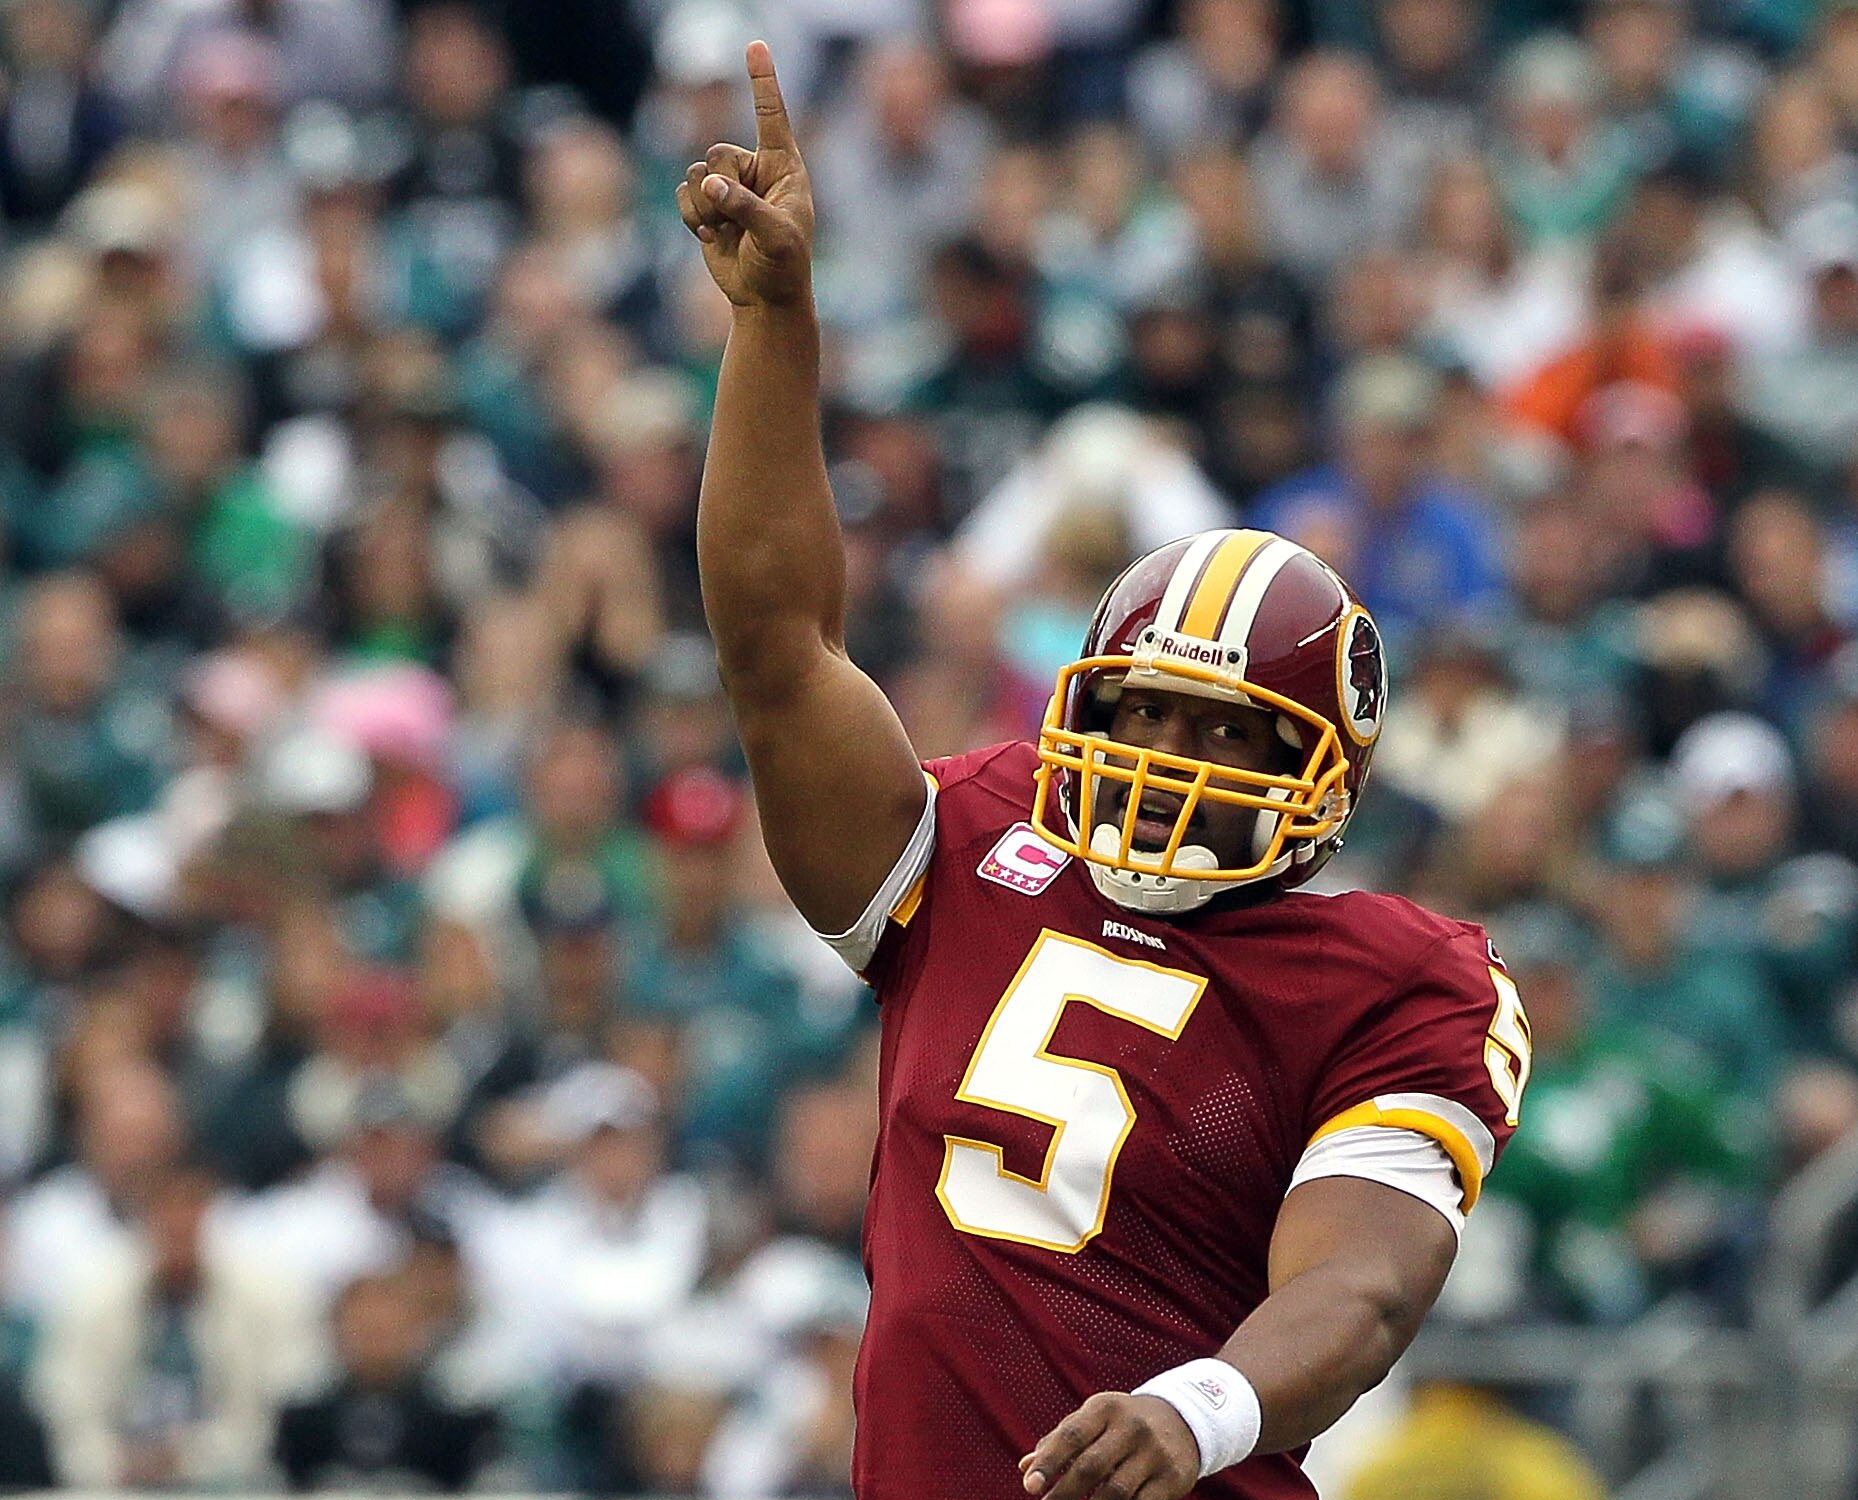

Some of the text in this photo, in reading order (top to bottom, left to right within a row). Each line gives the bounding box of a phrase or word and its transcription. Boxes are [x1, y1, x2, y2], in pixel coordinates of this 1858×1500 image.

[1161, 637, 1223, 666] Riddell
[935, 927, 1209, 1254] 5
[1483, 965, 1534, 1128] 5
